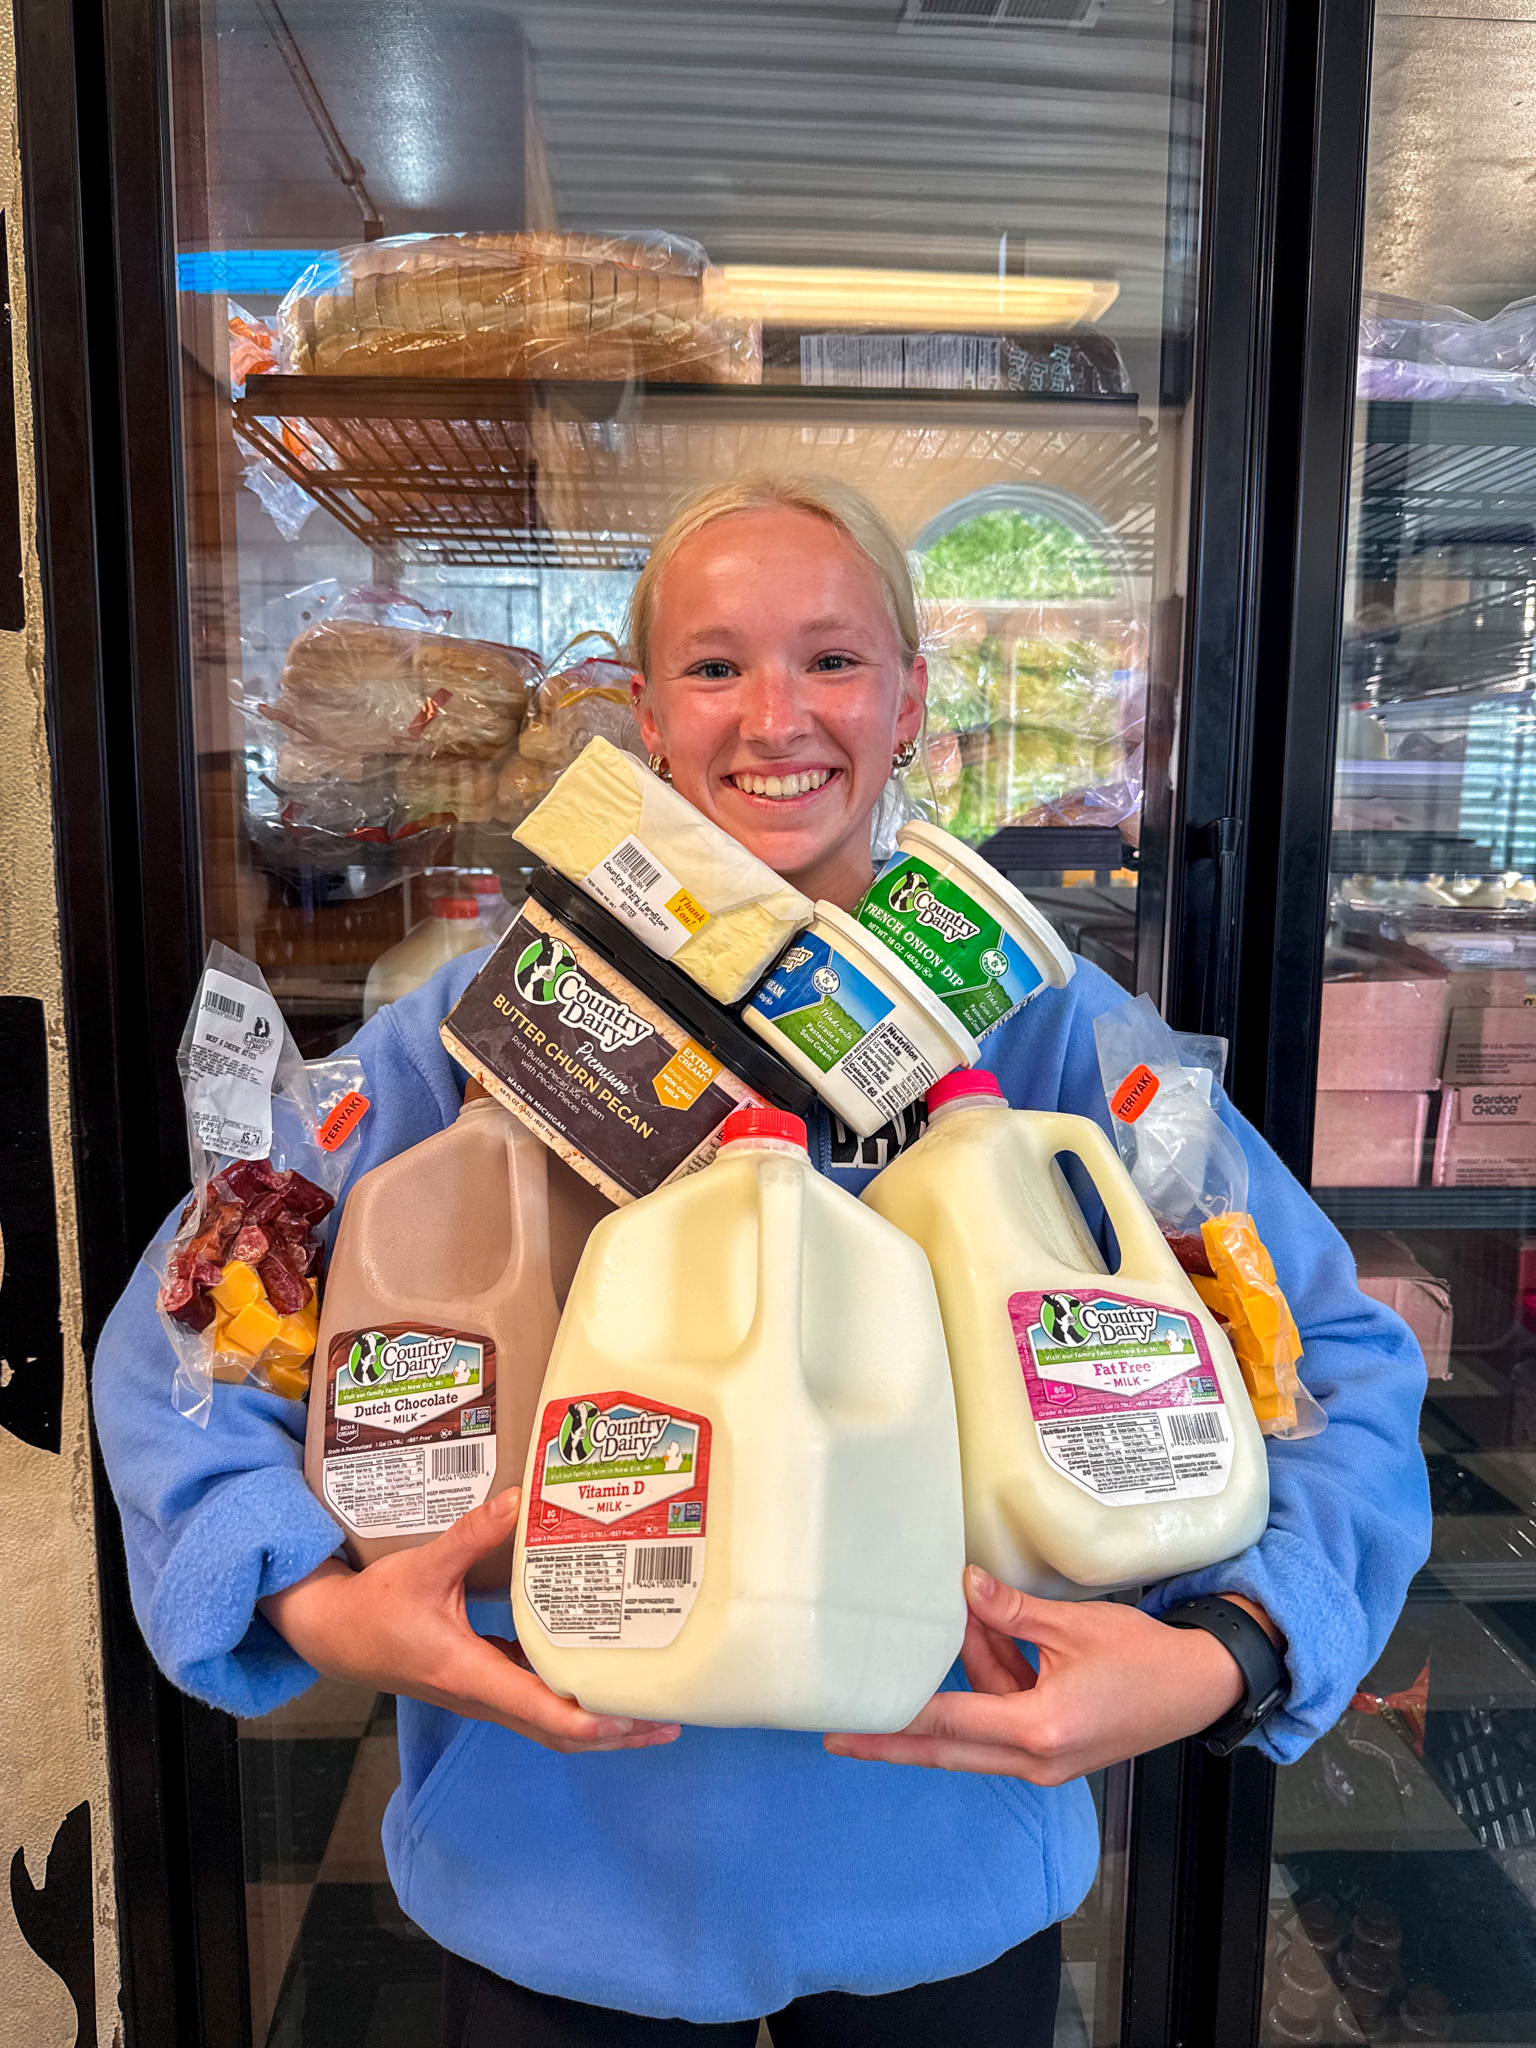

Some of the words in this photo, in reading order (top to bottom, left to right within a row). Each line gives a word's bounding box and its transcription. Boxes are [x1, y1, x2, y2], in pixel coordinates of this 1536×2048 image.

[603, 861, 626, 887] Country
[625, 885, 642, 903] Dairy
[620, 901, 637, 919] BUTTER
[674, 905, 697, 927] You!
[678, 895, 705, 923] Thank
[916, 893, 978, 936] Country
[918, 910, 962, 941] Dairy
[864, 902, 904, 936] FRENCH
[903, 932, 944, 969] ONION
[940, 965, 964, 988] DIP
[886, 936, 895, 945] 16
[894, 942, 905, 954] OZ.
[904, 950, 923, 970] (453g)
[992, 951, 1006, 967] PURE
[992, 959, 1000, 969] &
[822, 977, 830, 985] &
[823, 969, 837, 982] PURE
[558, 975, 650, 1042] Country
[962, 1009, 973, 1022] Sour
[978, 1001, 990, 1015] Grade
[562, 1001, 627, 1048] Dairy
[816, 1020, 835, 1040] Grade
[833, 1037, 841, 1045] A
[820, 1007, 839, 1029] Made
[838, 1026, 853, 1042] with
[206, 1034, 219, 1043] BEEF
[241, 1047, 257, 1060] BITES
[800, 1028, 815, 1045] Sour
[813, 1041, 833, 1061] Cream
[806, 1022, 840, 1055] Pasteurized
[841, 1053, 854, 1065] KEEP
[853, 1022, 886, 1054] REFRIGERATED
[879, 1033, 902, 1057] Facts
[886, 1026, 918, 1061] Nutrition
[492, 993, 547, 1047] BUTTER
[545, 1042, 600, 1094] CHURN
[597, 1088, 654, 1139] PECAN
[575, 1040, 631, 1095] Premium
[677, 1054, 710, 1083] CREAMY
[683, 1047, 714, 1077] EXTRA
[861, 1051, 881, 1072] Serving
[880, 1070, 890, 1081] size
[861, 1061, 874, 1073] tbsp
[867, 1046, 875, 1054] per
[874, 1053, 893, 1073] container
[877, 1047, 895, 1067] servings
[510, 1034, 527, 1051] Rich
[526, 1048, 549, 1069] Butter
[549, 1068, 570, 1091] Pecan
[568, 1085, 582, 1100] Ice
[579, 1095, 605, 1121] Cream
[668, 1067, 683, 1083] Made
[681, 1079, 698, 1095] From
[844, 1066, 852, 1074] per
[849, 1062, 871, 1086] Calories
[520, 1058, 537, 1076] with
[535, 1072, 558, 1095] Pecan
[557, 1091, 581, 1114] Pieces
[662, 1072, 693, 1101] NON-GMO
[663, 1085, 681, 1101] MILK
[866, 1087, 878, 1097] 60
[1117, 1072, 1152, 1117] TERIYAKI
[499, 1087, 508, 1096] 48
[505, 1091, 513, 1100] FL
[511, 1097, 520, 1108] OZ
[533, 1117, 546, 1131] rBST
[506, 1076, 527, 1097] MADE
[525, 1094, 535, 1104] IN
[533, 1100, 567, 1132] MICHIGAN
[1473, 1094, 1518, 1105] Gordon
[323, 1096, 363, 1147] TERIYAKI
[1082, 1308, 1155, 1331] Country
[1102, 1324, 1149, 1342] Dairy
[382, 1340, 454, 1366] Country
[395, 1355, 443, 1379] Dairy
[1092, 1363, 1117, 1376] Fat
[1118, 1361, 1151, 1374] Free
[343, 1393, 355, 1401] Visit
[366, 1388, 384, 1398] family
[385, 1386, 399, 1394] farm
[407, 1383, 421, 1391] New
[1053, 1386, 1066, 1394] 8G
[1113, 1377, 1141, 1387] MILK
[354, 1401, 391, 1418] Dutch
[394, 1392, 459, 1412] Chocolate
[1063, 1405, 1097, 1414] Pasteurized
[393, 1413, 418, 1425] MILK
[592, 1416, 669, 1443] Country
[1042, 1428, 1066, 1436] Nutrition
[1066, 1425, 1081, 1433] Facts
[338, 1430, 357, 1438] CREAMY
[327, 1448, 340, 1456] Grade
[345, 1442, 373, 1452] Pasteurized
[604, 1436, 654, 1459] Dairy
[573, 1469, 591, 1477] family
[578, 1482, 629, 1500] Vitamin
[633, 1480, 645, 1495] D
[546, 1509, 556, 1518] 8G
[596, 1501, 622, 1513] MILK
[547, 1533, 573, 1541] Pasteurized
